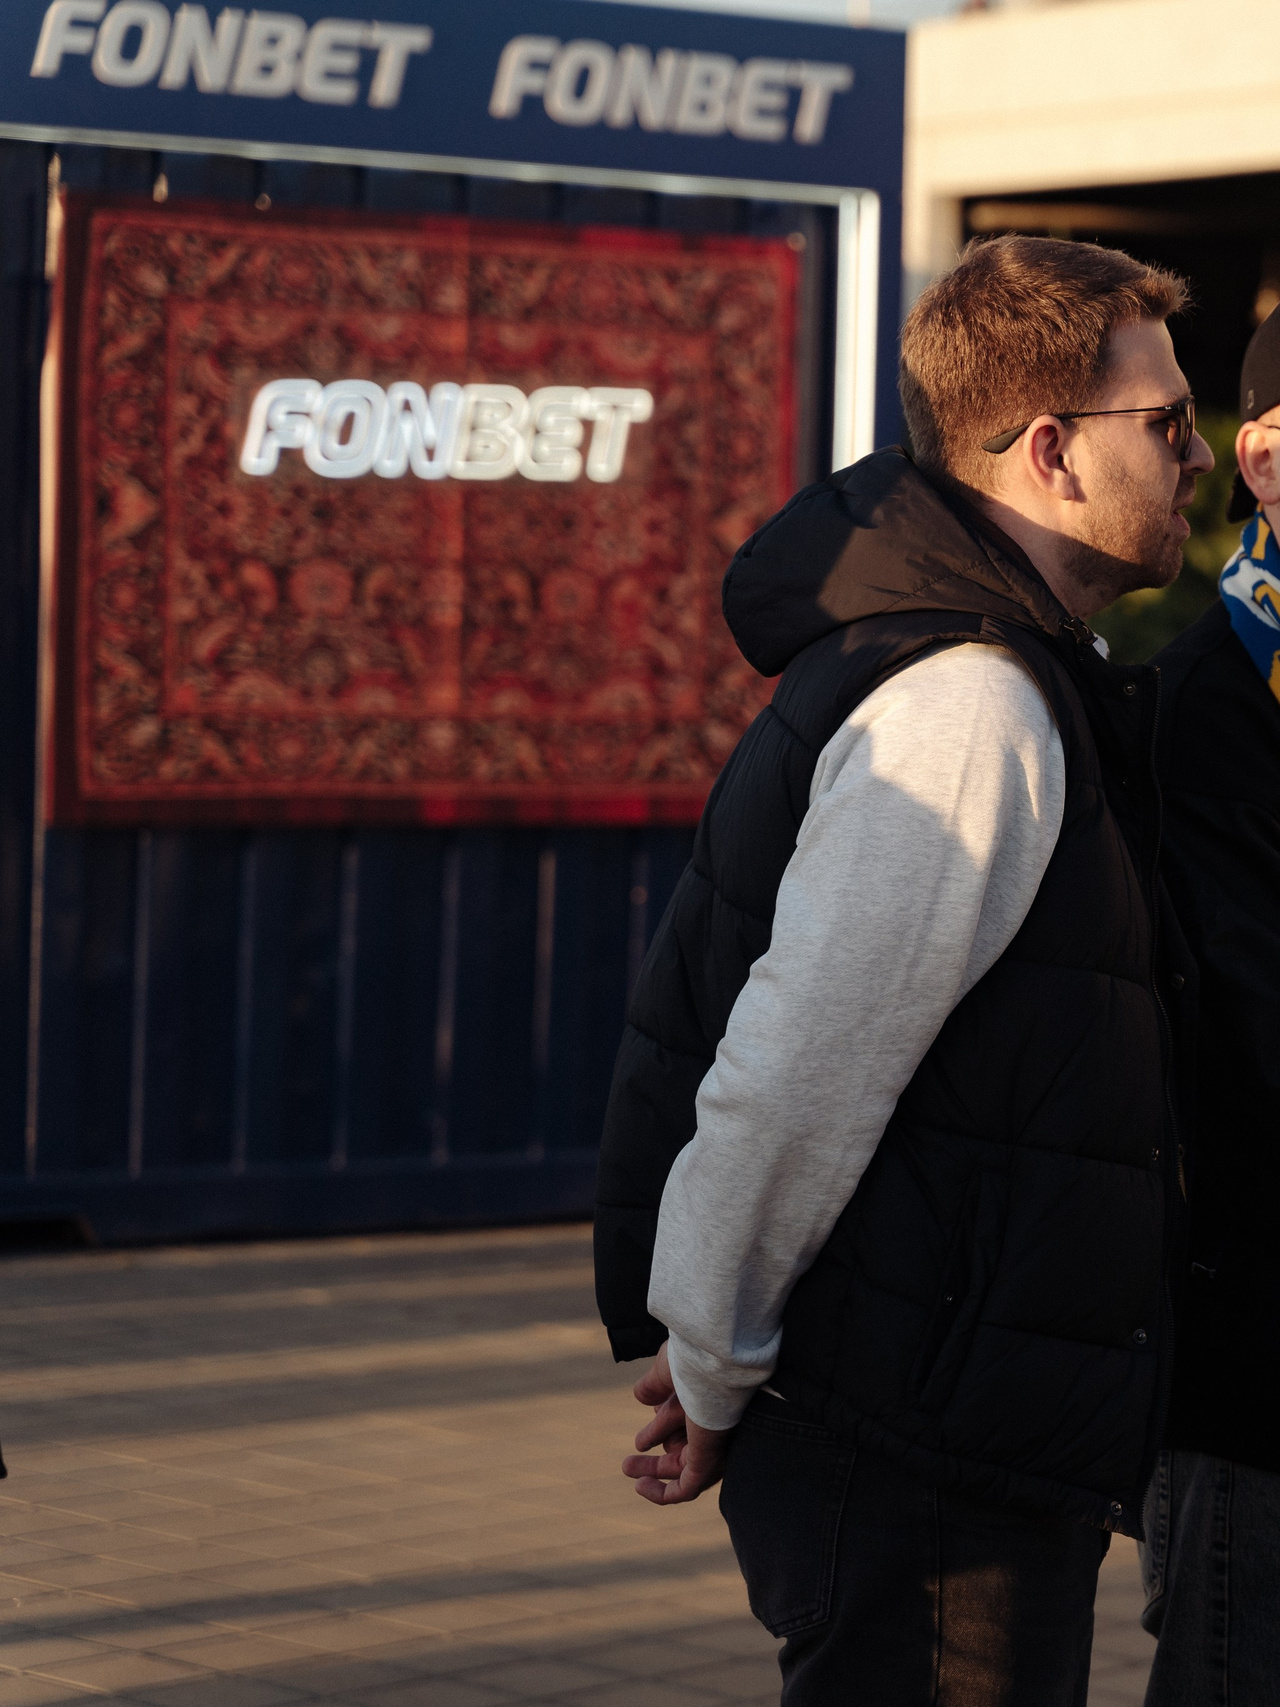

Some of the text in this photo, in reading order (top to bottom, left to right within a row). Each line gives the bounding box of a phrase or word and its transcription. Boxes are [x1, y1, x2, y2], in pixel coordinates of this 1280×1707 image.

[31, 0, 432, 108] FONBET
[489, 35, 854, 144] FONBET
[240, 378, 654, 483] FONBET
